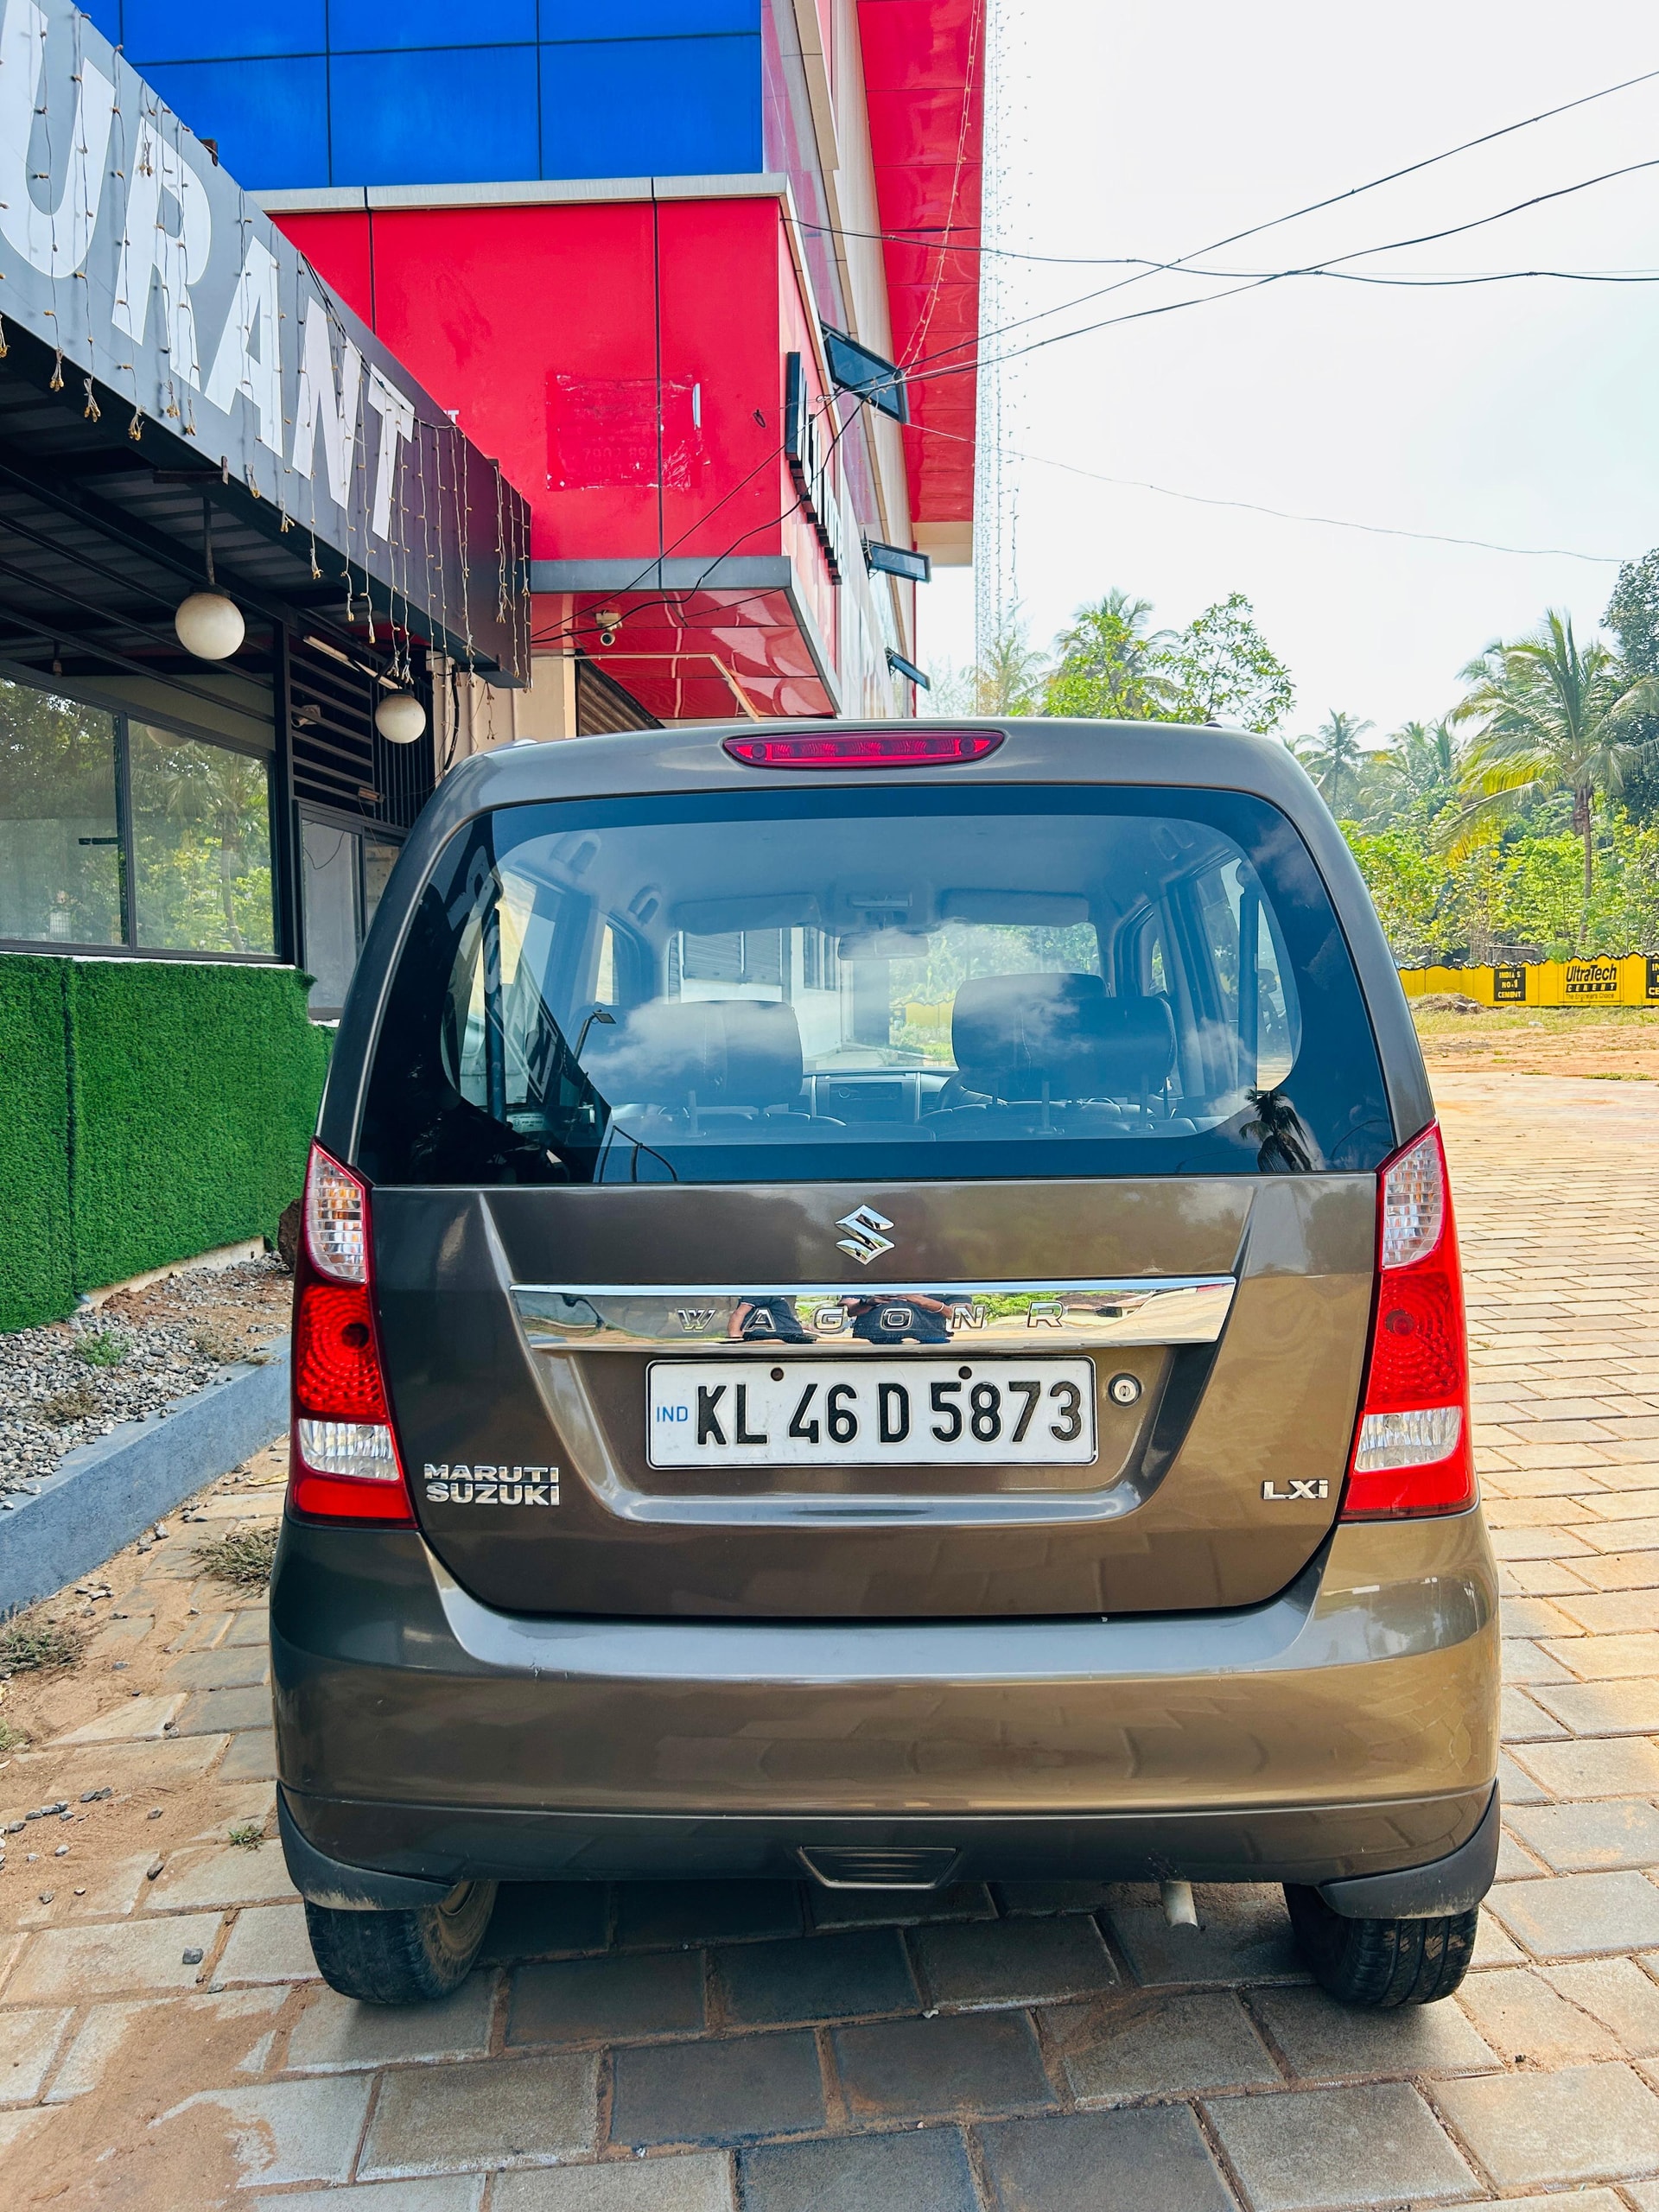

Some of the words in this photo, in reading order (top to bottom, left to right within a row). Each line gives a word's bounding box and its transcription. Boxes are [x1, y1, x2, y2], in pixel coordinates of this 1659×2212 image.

[1566, 963, 1617, 982] UltraTech
[1567, 983, 1616, 992] CEMENT
[656, 1406, 689, 1423] IND
[696, 1385, 769, 1446] KL
[788, 1383, 859, 1446] 46
[879, 1382, 910, 1444] D
[930, 1381, 1083, 1443] 5873
[423, 1464, 560, 1483] MARUTI
[425, 1482, 561, 1505] SUZUKI
[1263, 1479, 1329, 1500] LXi
